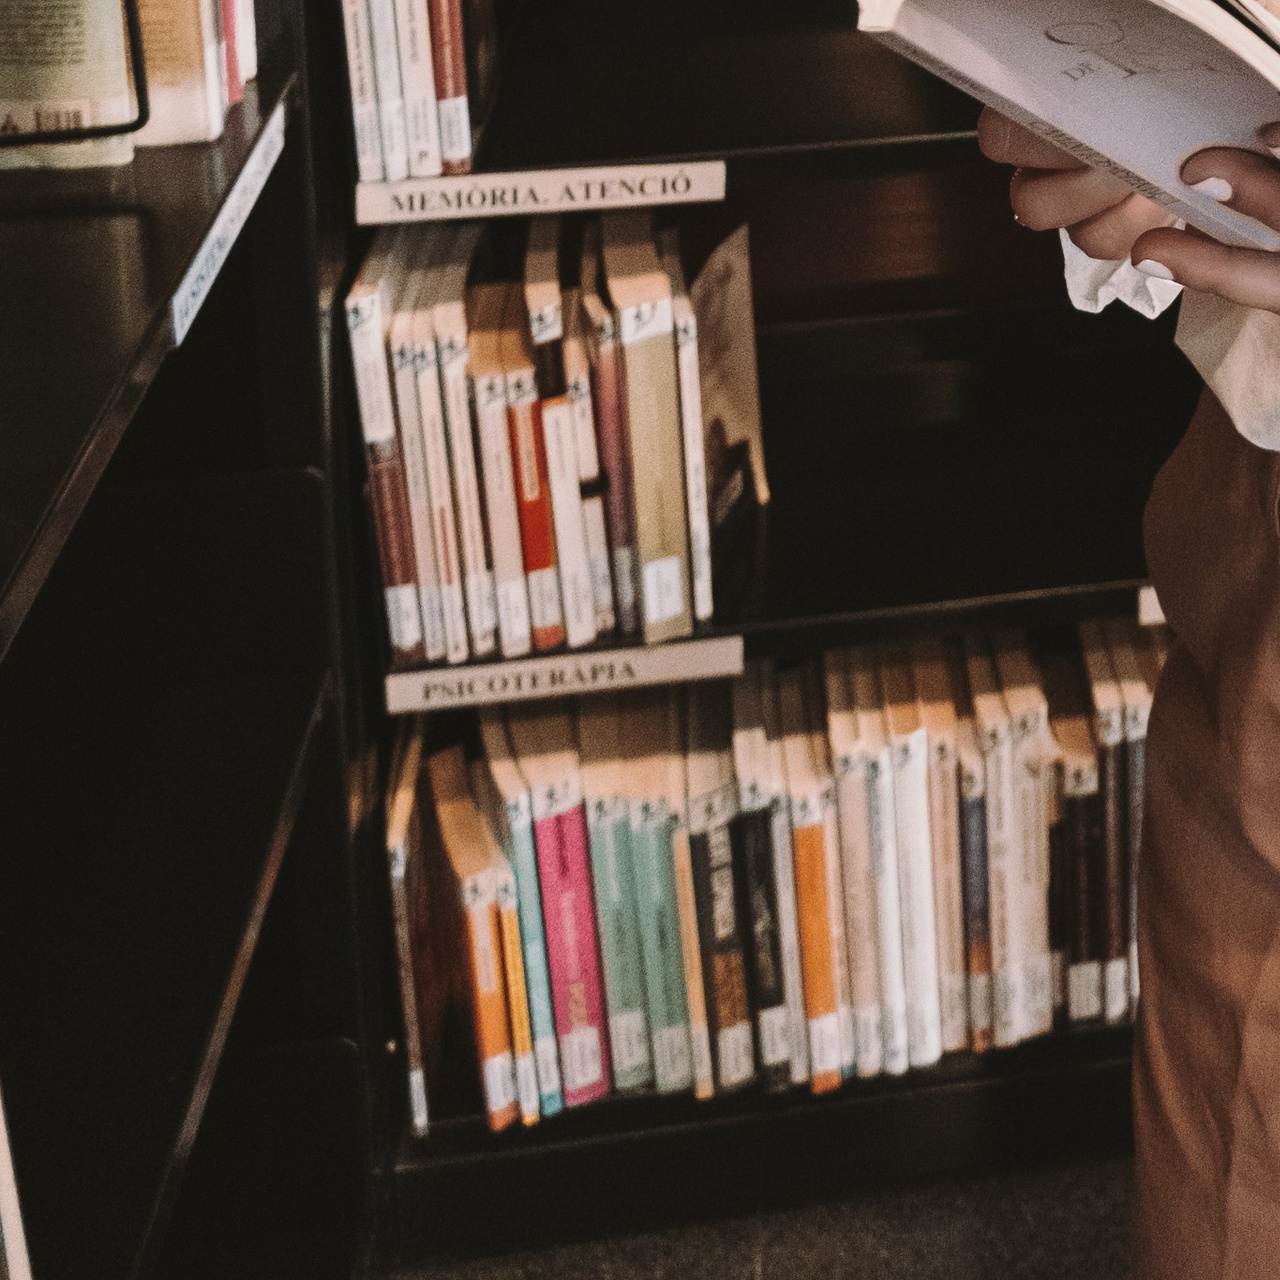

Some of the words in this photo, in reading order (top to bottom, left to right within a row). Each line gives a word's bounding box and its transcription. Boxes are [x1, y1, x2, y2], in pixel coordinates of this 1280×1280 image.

[390, 182, 549, 216] MEMÒRIA.
[557, 170, 693, 204] ATENCIÓ
[421, 661, 637, 702] PSICOTERÀPIA
